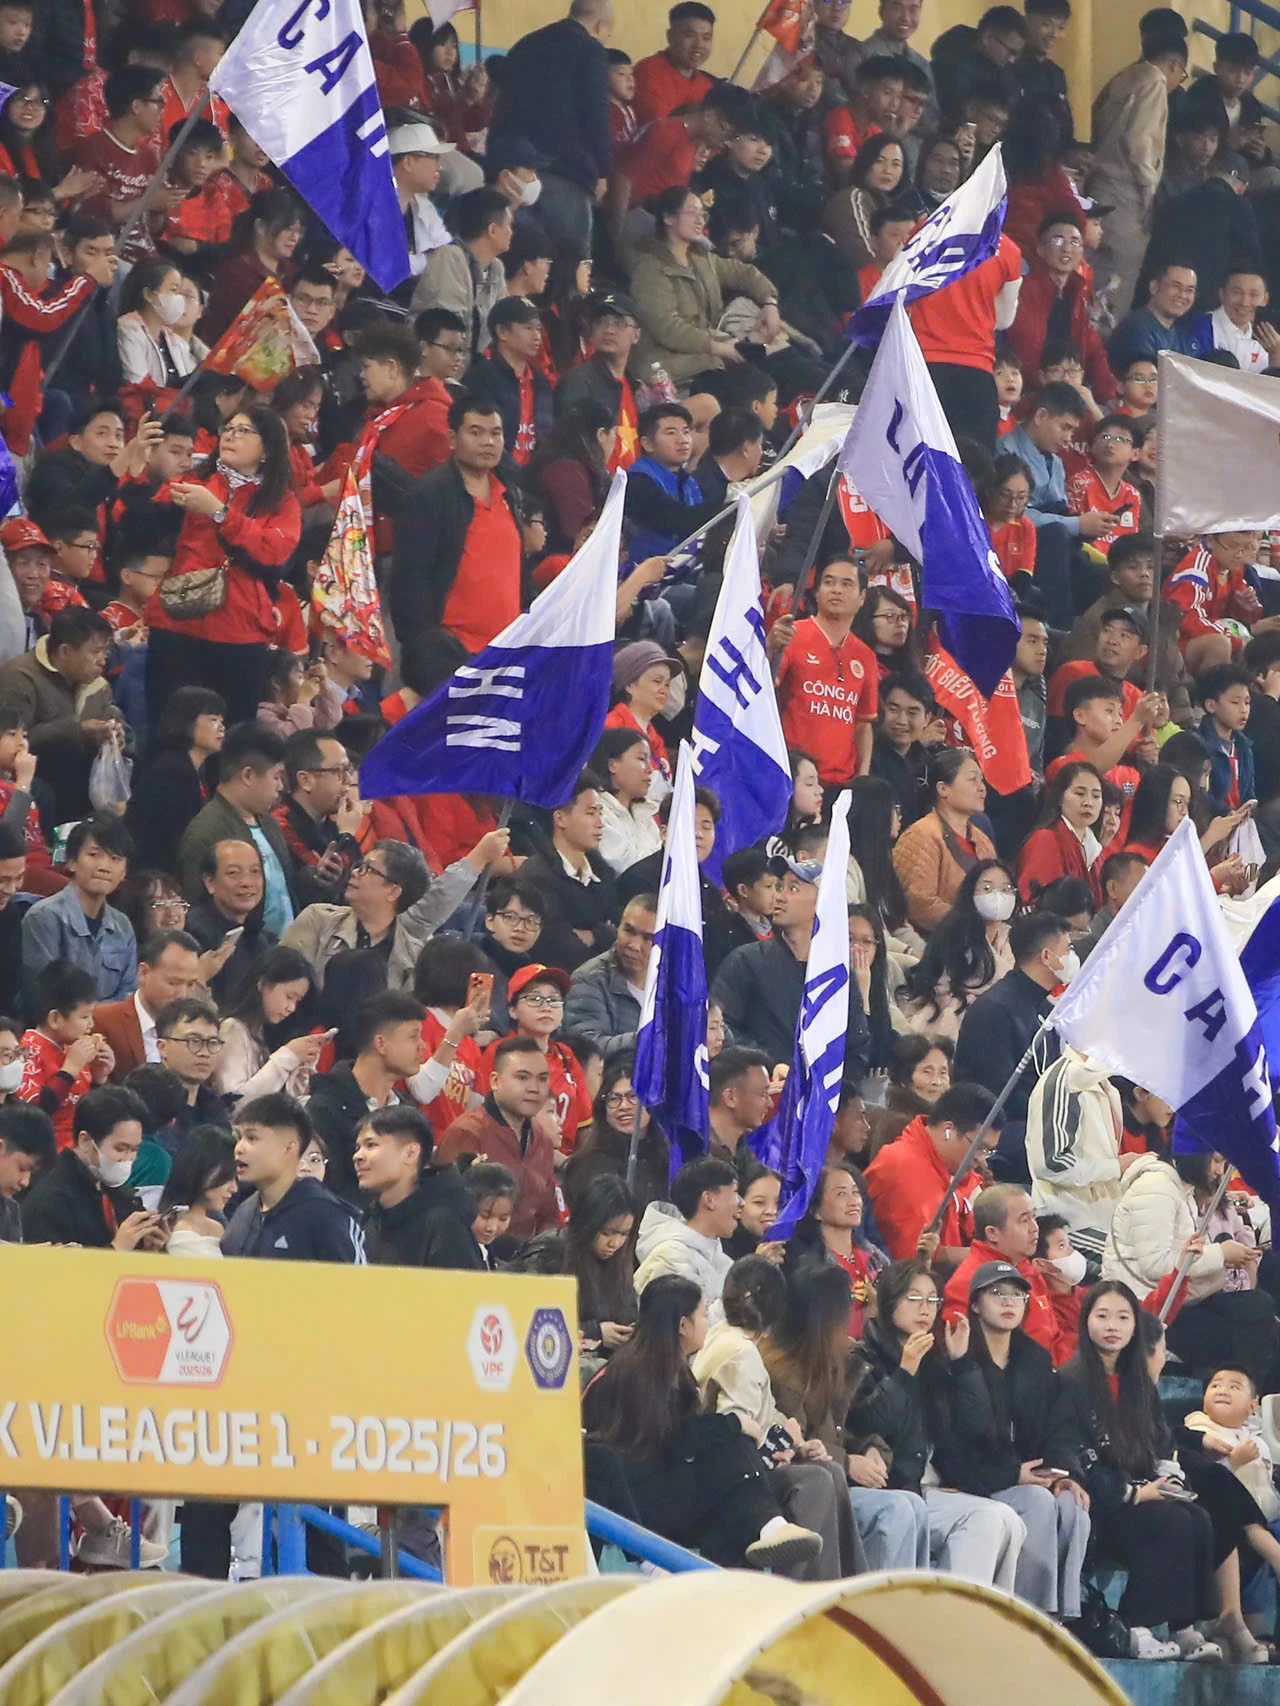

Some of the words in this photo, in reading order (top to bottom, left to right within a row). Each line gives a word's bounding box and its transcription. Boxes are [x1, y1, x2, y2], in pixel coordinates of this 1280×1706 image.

[803, 680, 845, 701] CÔNG
[810, 700, 831, 717] HÀ
[481, 1361, 504, 1377] VPF
[29, 1402, 261, 1468] V.LEAGUE
[270, 1412, 296, 1469] 1
[329, 1415, 508, 1484] 2025/26
[523, 1545, 569, 1573] T&T
